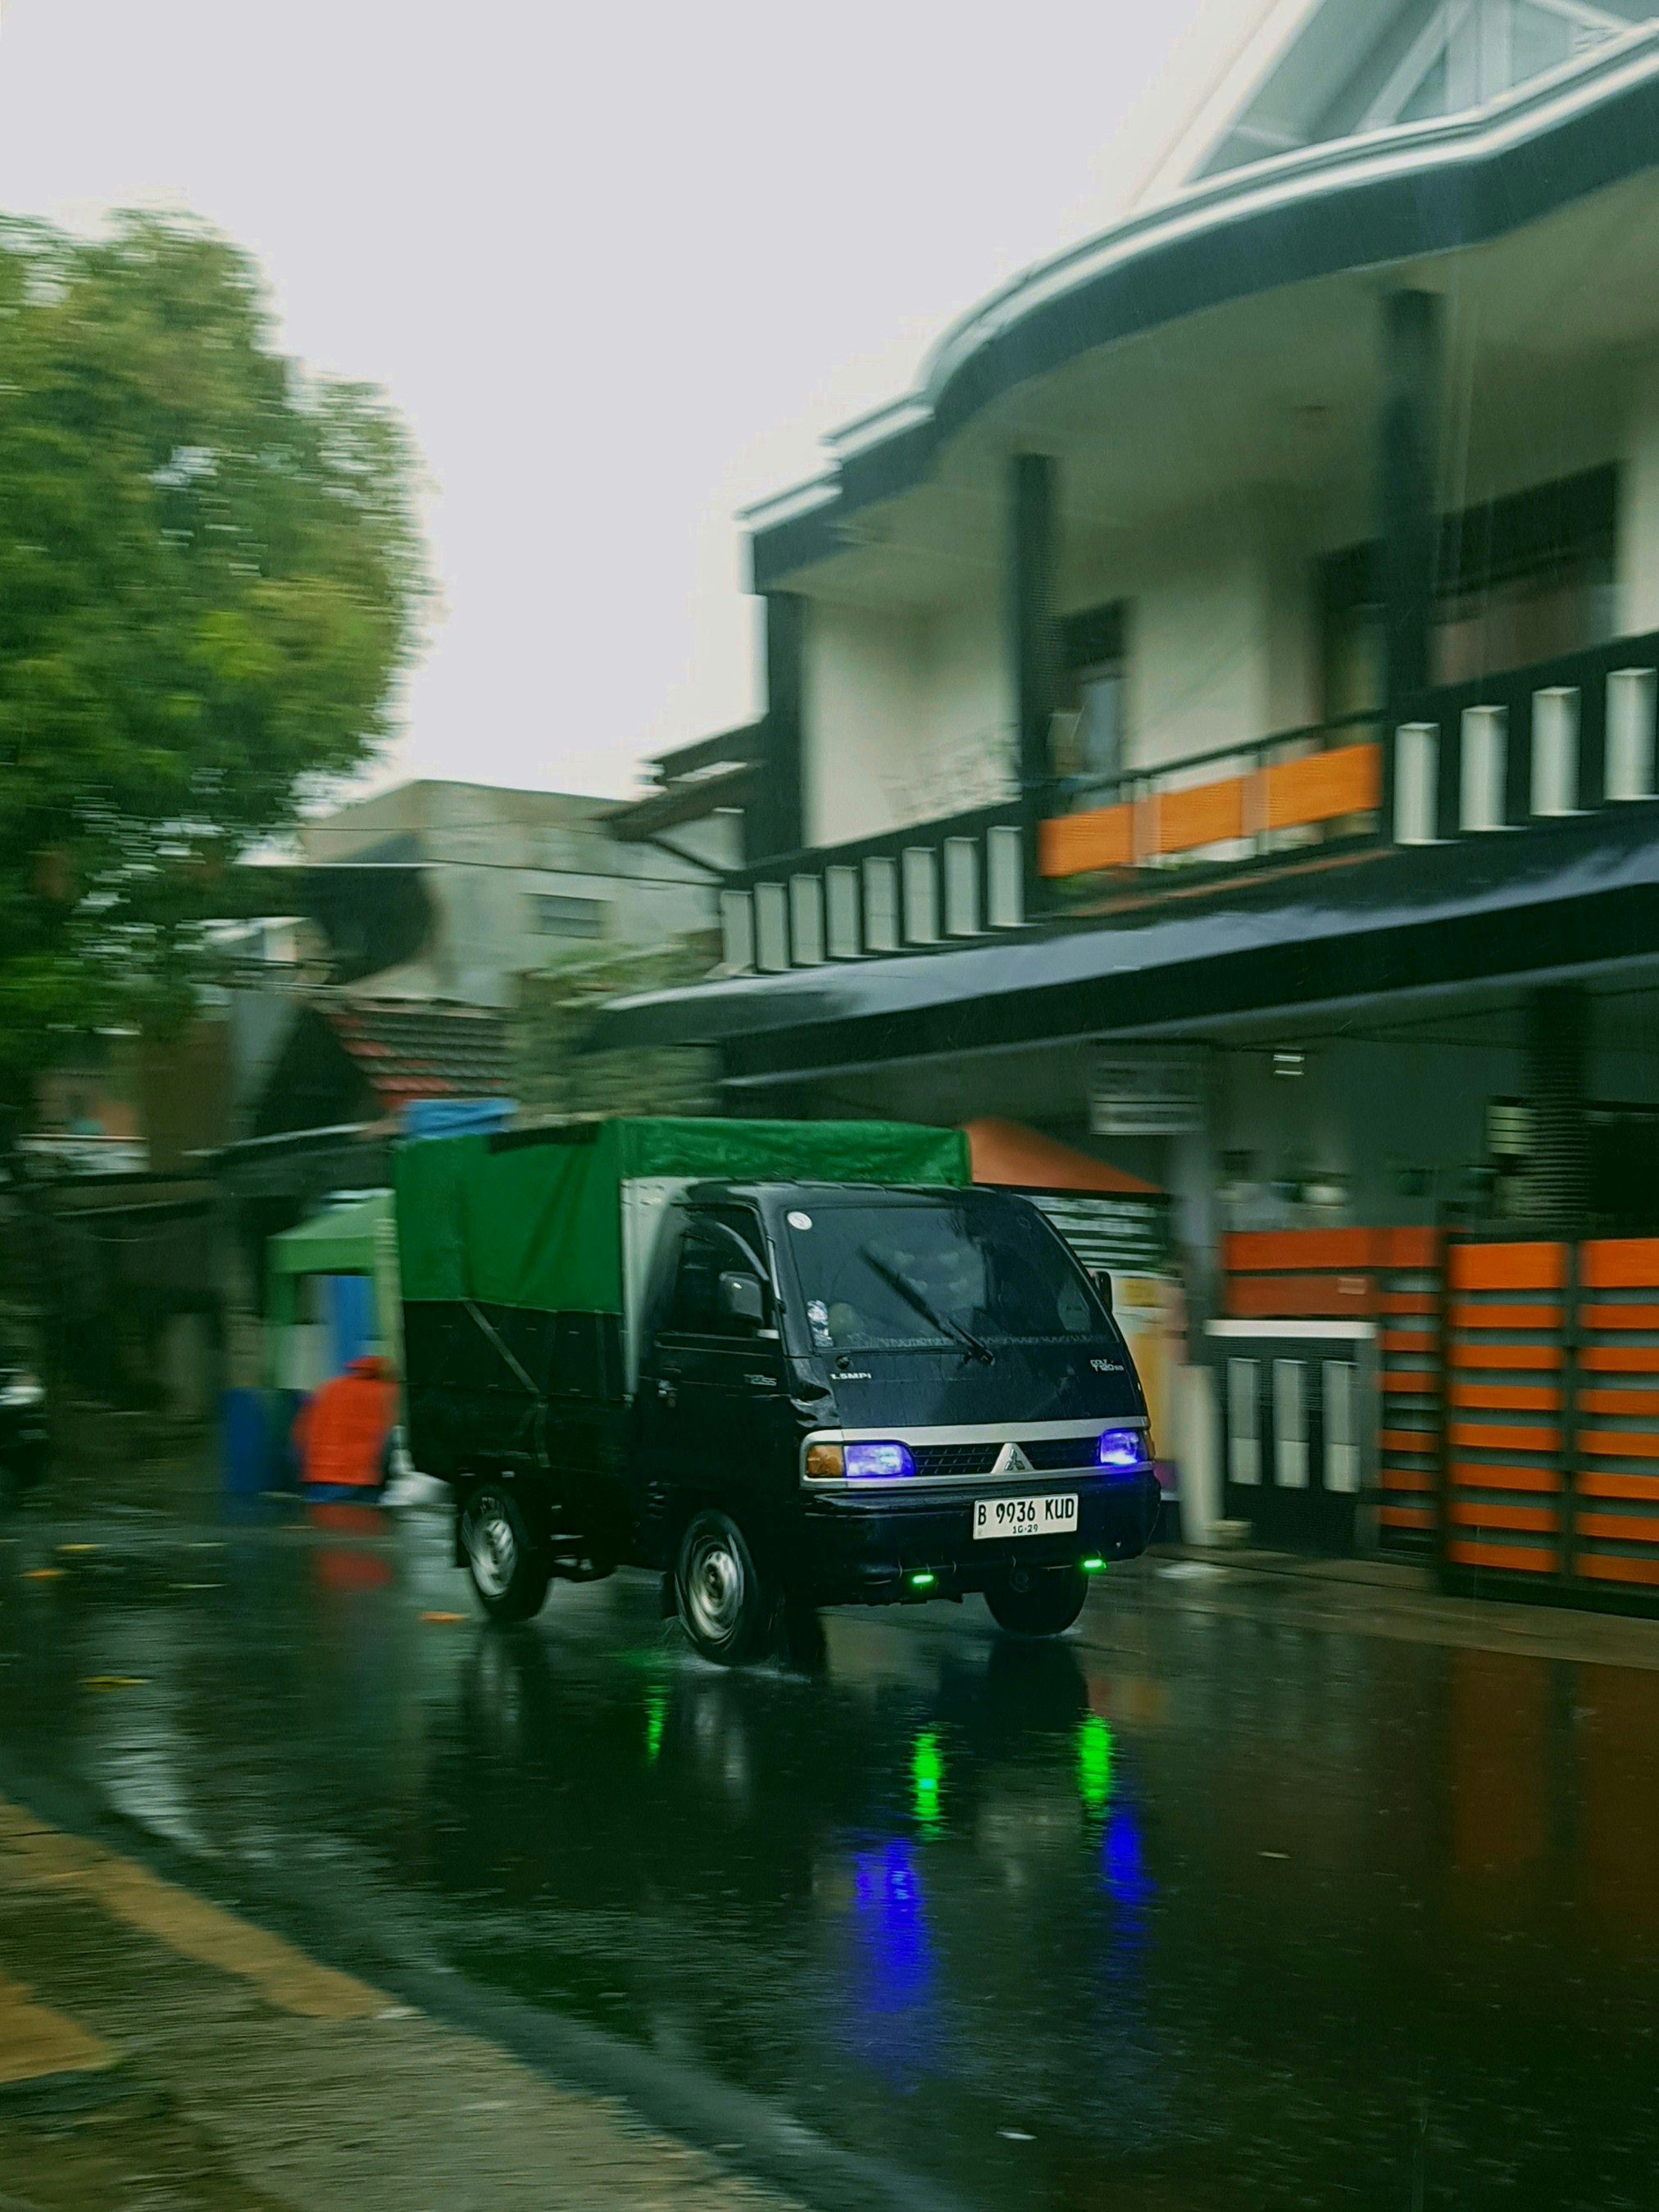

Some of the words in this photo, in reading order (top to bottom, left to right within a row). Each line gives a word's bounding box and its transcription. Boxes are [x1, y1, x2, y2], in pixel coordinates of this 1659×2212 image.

[978, 1504, 987, 1525] B
[996, 1501, 1036, 1524] 9936
[1045, 1498, 1075, 1520] KUD
